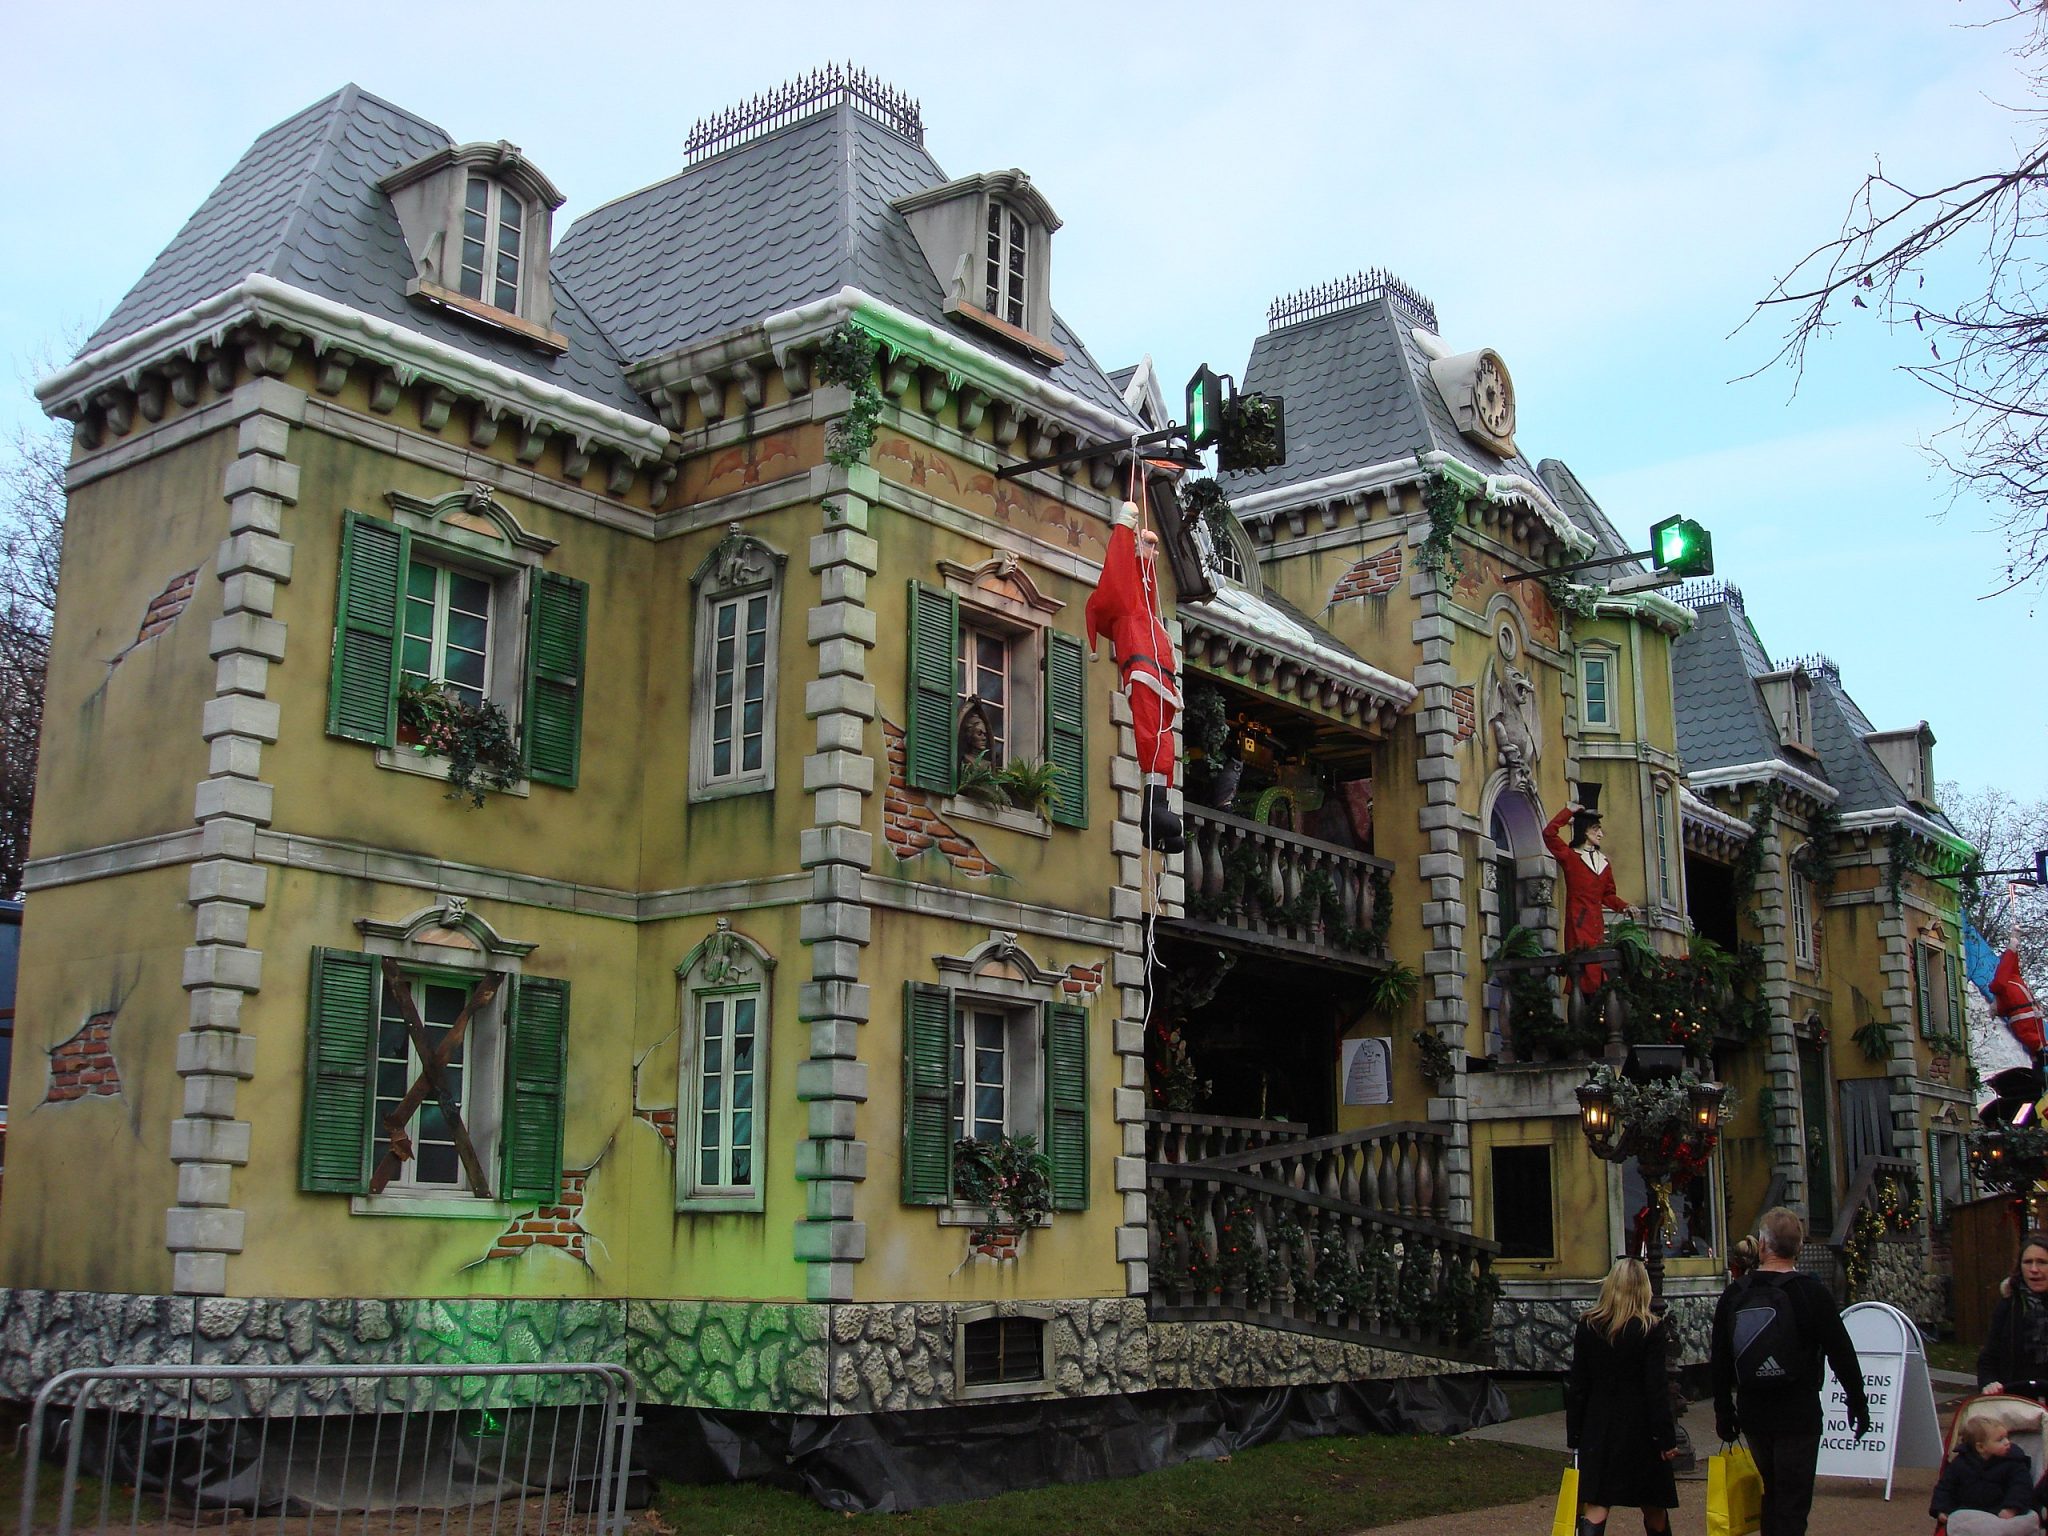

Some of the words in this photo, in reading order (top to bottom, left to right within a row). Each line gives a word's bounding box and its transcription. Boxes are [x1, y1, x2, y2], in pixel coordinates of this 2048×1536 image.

[1755, 1368, 1786, 1377] adidas
[1831, 1376, 1838, 1385] 4
[1863, 1375, 1891, 1386] KENS
[1831, 1392, 1849, 1404] PE
[1866, 1393, 1888, 1405] IDE
[1827, 1419, 1847, 1432] NO
[1850, 1421, 1885, 1434] CSH
[1821, 1438, 1886, 1452] ACCEPTED
